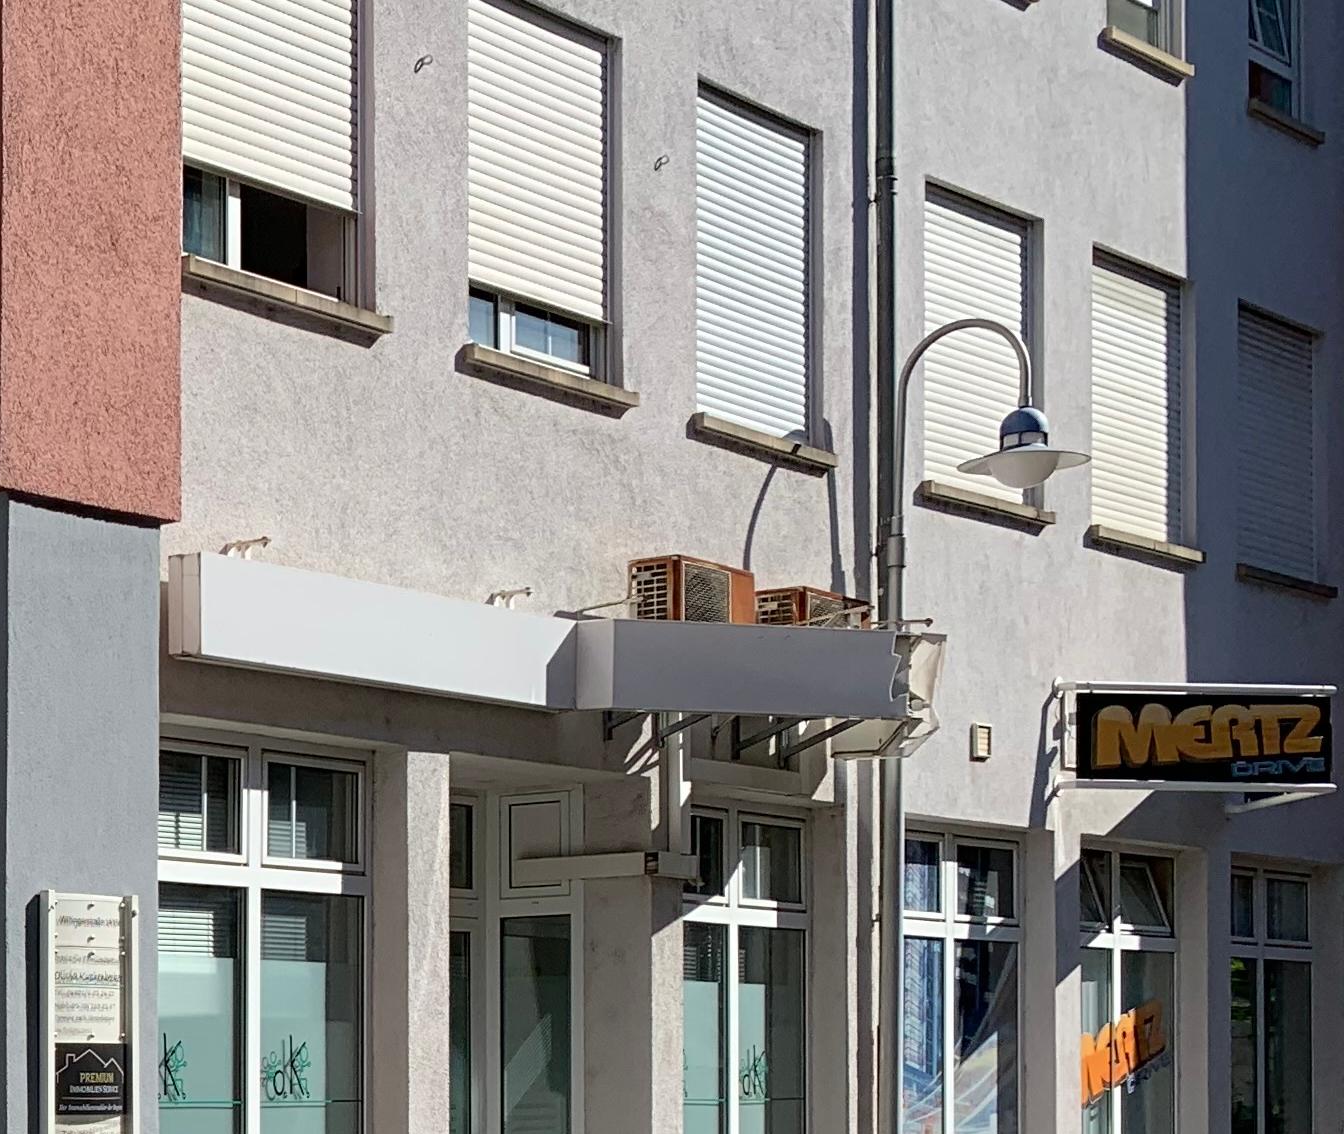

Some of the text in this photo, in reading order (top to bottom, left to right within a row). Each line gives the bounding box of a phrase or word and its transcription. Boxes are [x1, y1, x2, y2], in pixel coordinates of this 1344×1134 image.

[1093, 703, 1324, 769] MERTZ
[1231, 757, 1326, 777] DRIVE
[79, 1071, 114, 1083] PREMIUM
